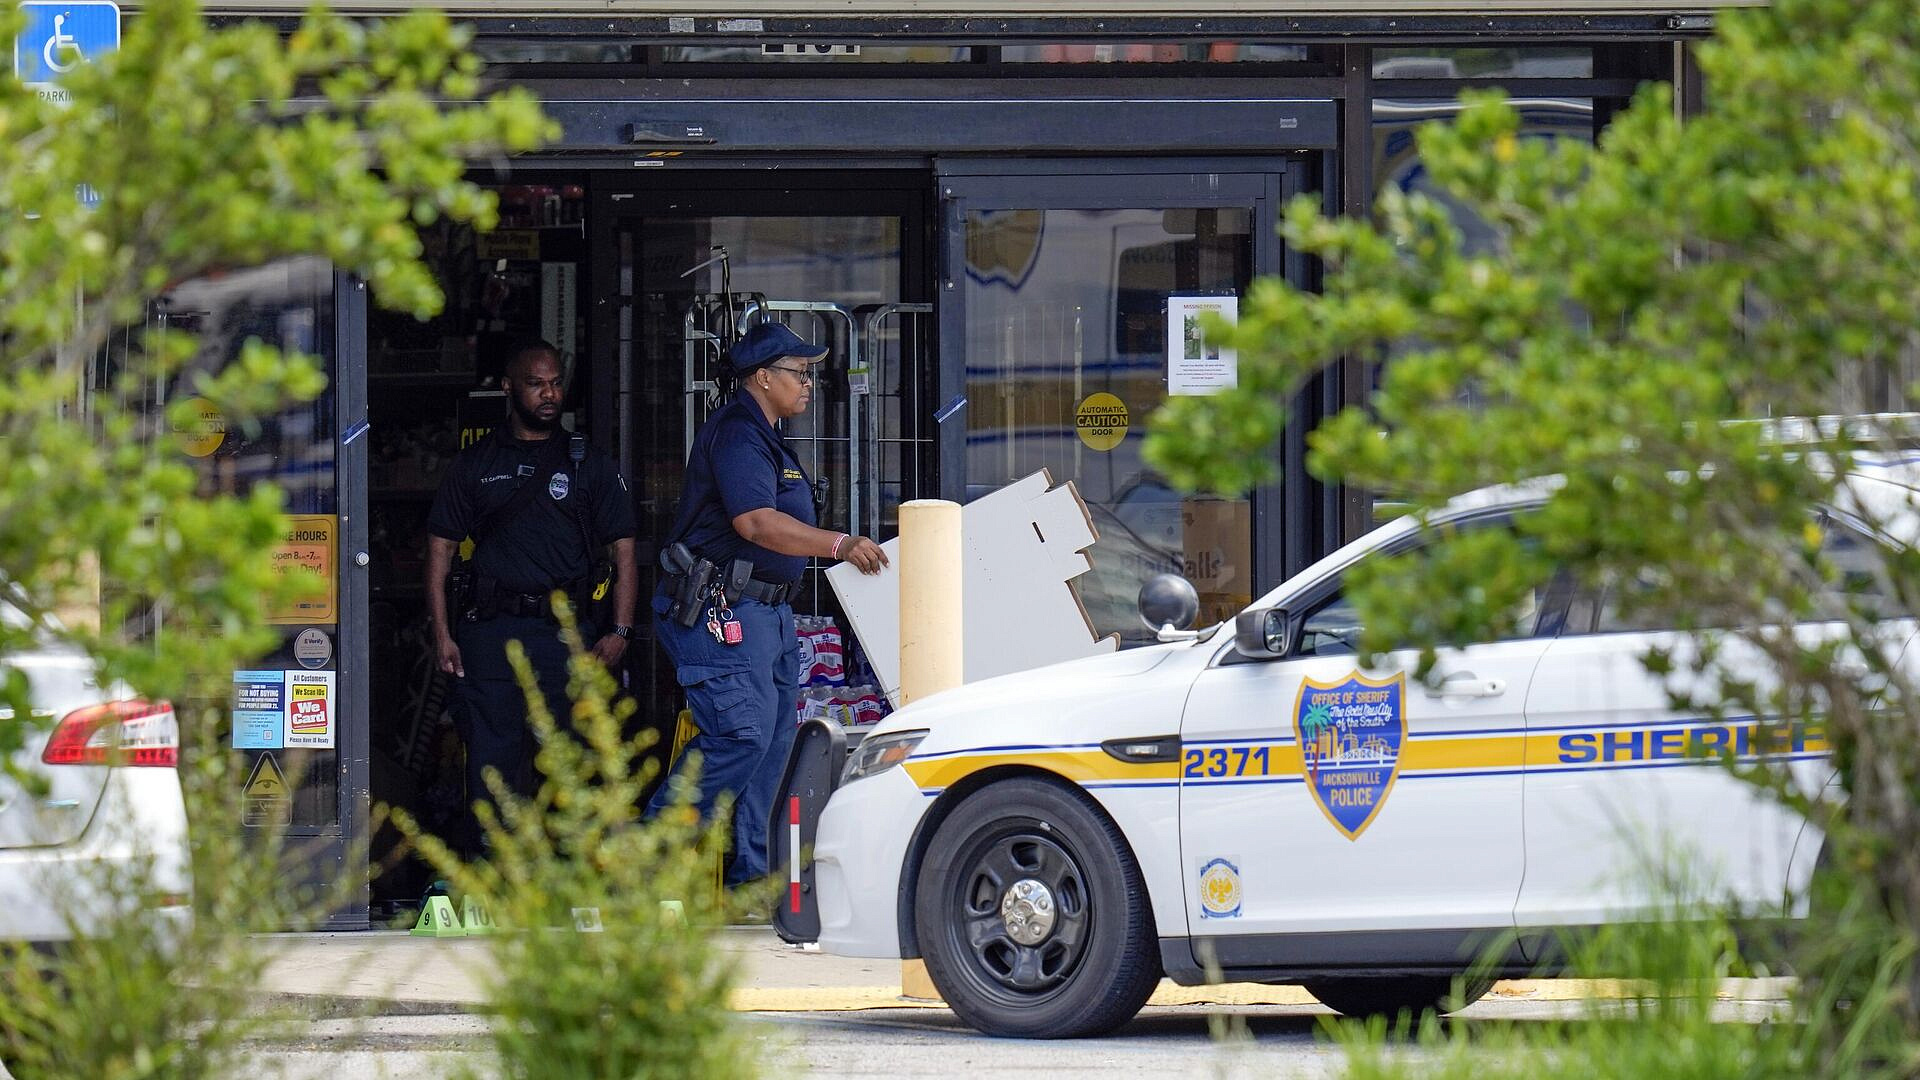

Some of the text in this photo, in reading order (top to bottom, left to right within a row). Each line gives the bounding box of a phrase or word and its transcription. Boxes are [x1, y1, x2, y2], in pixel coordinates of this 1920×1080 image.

[39, 90, 75, 102] PARKIN
[1081, 406, 1124, 414] AUTOMATIC
[1077, 415, 1128, 427] CAUTION
[295, 530, 328, 542] HOURS
[271, 551, 293, 561] Open
[301, 674, 327, 683] Customers
[238, 689, 279, 697] FOR NOT BUYING
[294, 688, 303, 696] We
[303, 688, 316, 696] Scan
[1312, 690, 1390, 705] OFFICE OF SHERIFF
[297, 702, 321, 714] We
[1330, 705, 1345, 717] The
[291, 711, 326, 725] Card
[1336, 715, 1386, 732] of the South
[1184, 746, 1270, 778] 2371
[1322, 771, 1381, 787] JACKSONVILLE
[1330, 788, 1374, 807] POLICE
[424, 904, 490, 928] 9 9 10
